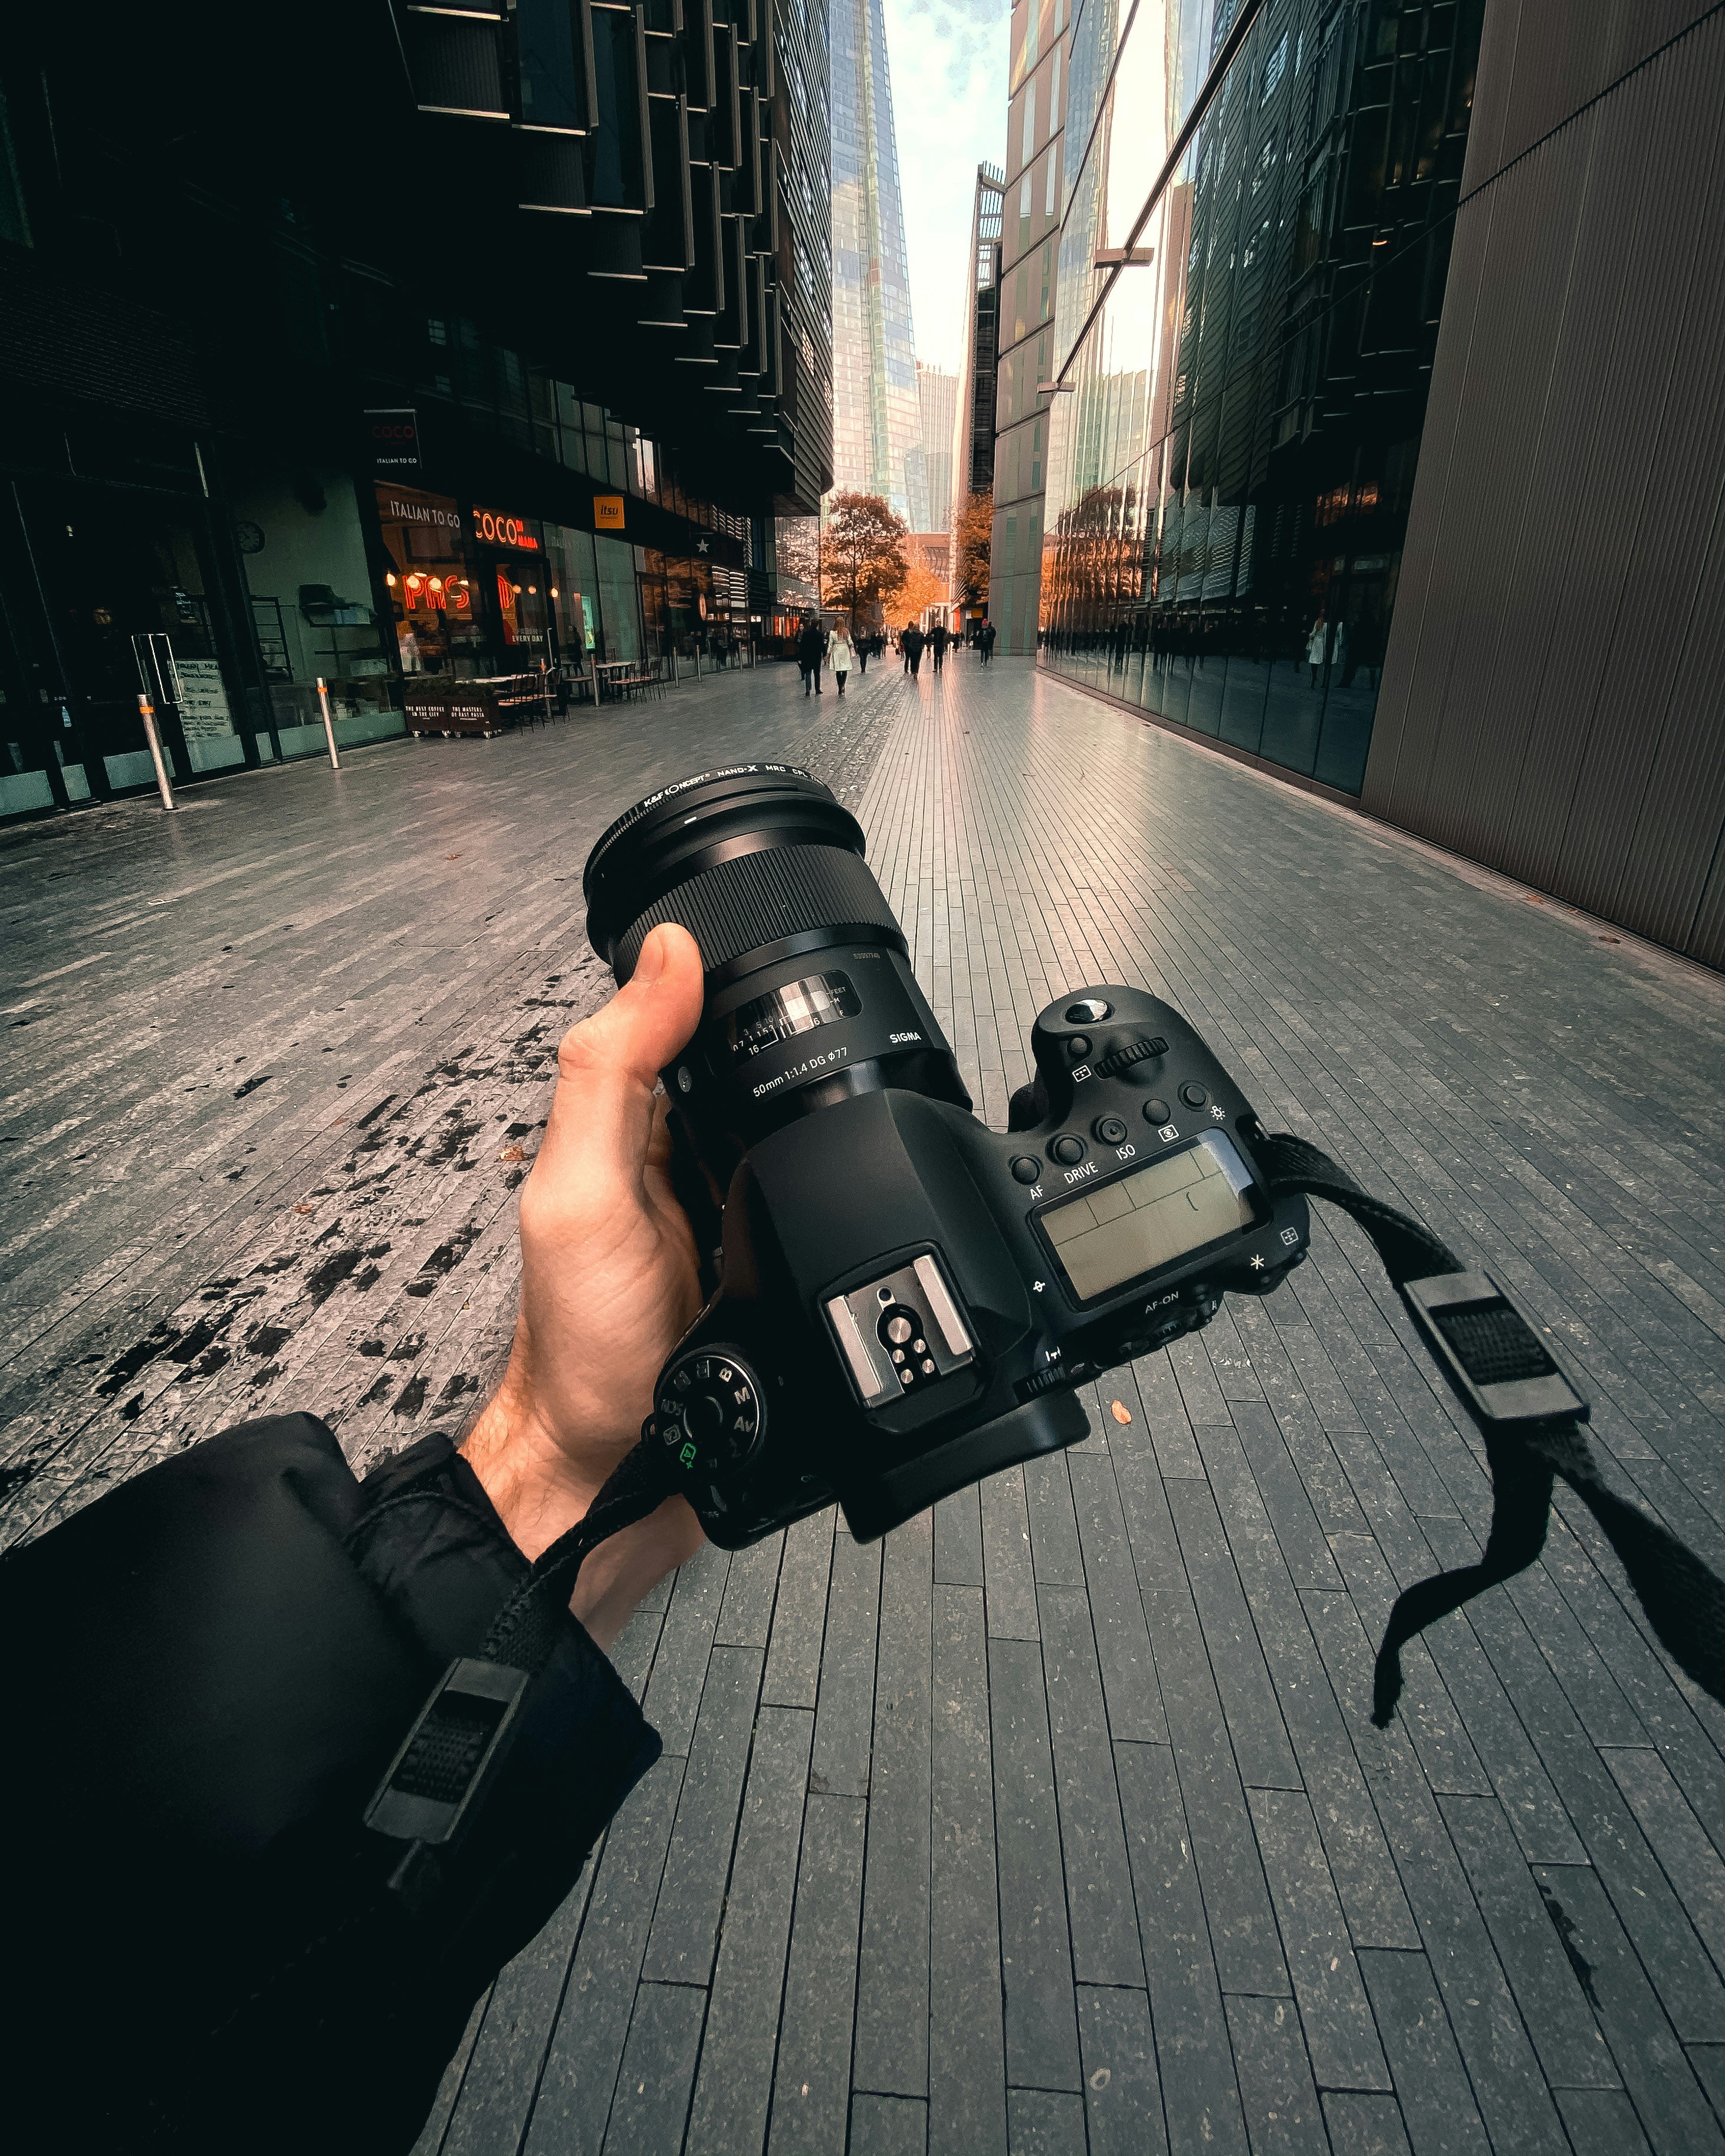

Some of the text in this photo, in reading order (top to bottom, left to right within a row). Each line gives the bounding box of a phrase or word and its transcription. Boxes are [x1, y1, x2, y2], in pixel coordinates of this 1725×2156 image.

[372, 425, 415, 439] COCO
[390, 500, 461, 528] ITALIAN TO GO
[600, 504, 619, 515] itsu
[643, 791, 663, 807] K&F
[717, 765, 759, 777] NANO-X
[791, 768, 809, 778] CPL
[889, 1031, 922, 1044] SIGMA
[748, 1044, 759, 1055] 16
[753, 1076, 784, 1097] 50mm
[784, 1063, 808, 1080] 1:1.4
[809, 1055, 827, 1069] DG
[1115, 1144, 1136, 1161] ISO
[1063, 1161, 1099, 1184] DRIVE
[1030, 1185, 1044, 1201] AF
[1145, 1291, 1179, 1314] AF-ON
[718, 1367, 733, 1382] B
[734, 1386, 751, 1405] M
[733, 1415, 755, 1432] Av
